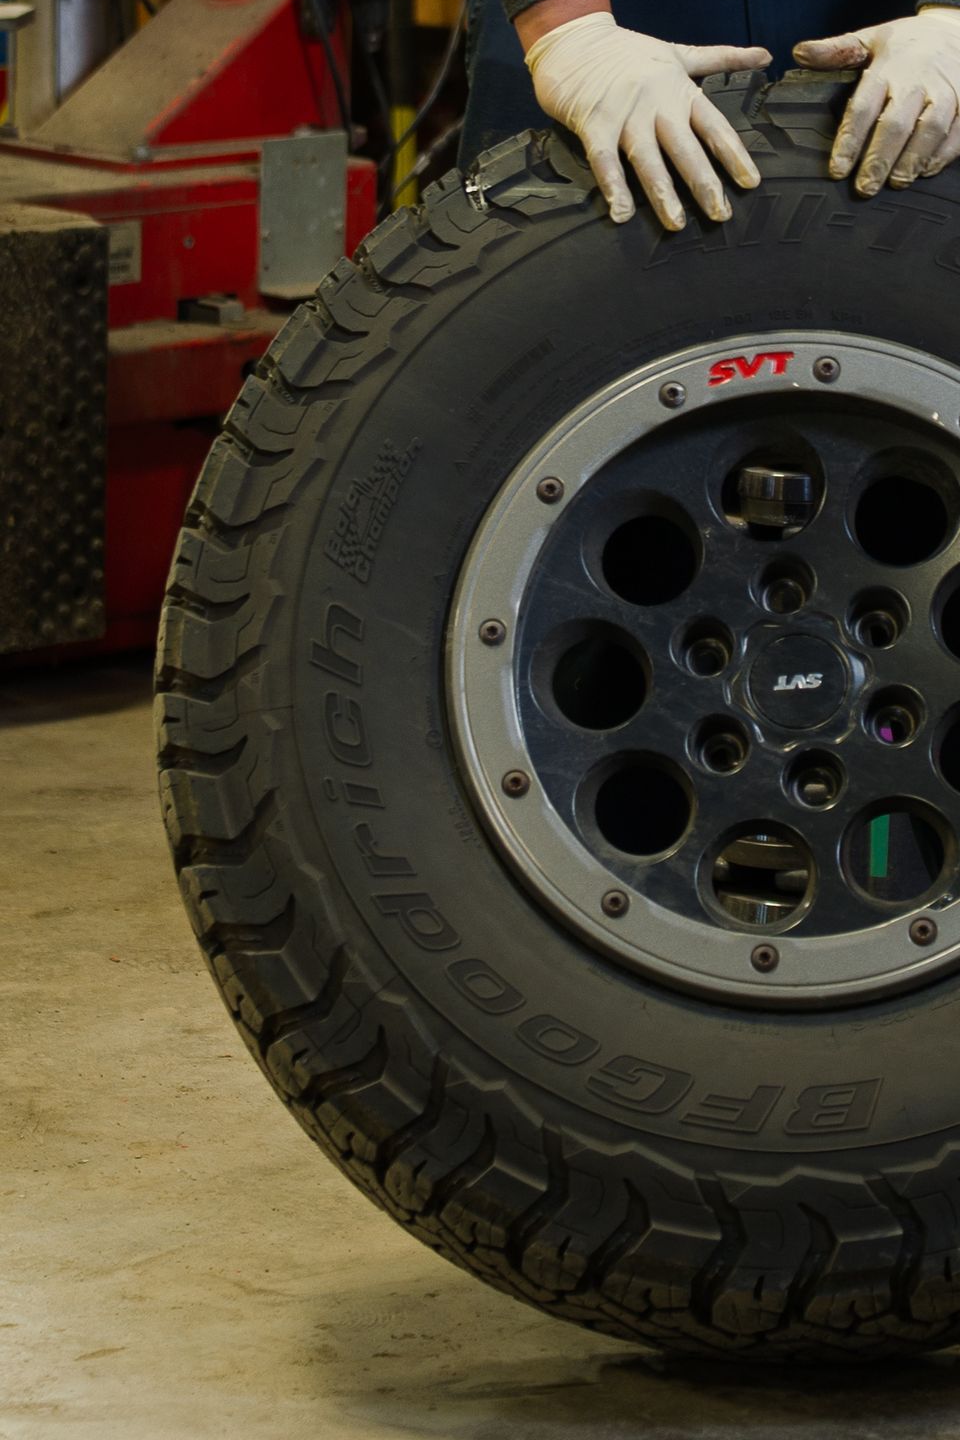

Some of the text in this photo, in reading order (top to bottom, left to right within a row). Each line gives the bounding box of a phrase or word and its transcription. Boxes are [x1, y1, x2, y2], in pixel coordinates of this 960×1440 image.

[707, 351, 795, 387] SVT
[325, 479, 363, 565] Baja
[347, 436, 424, 584] Champion
[307, 601, 883, 1136] BFGoodrich
